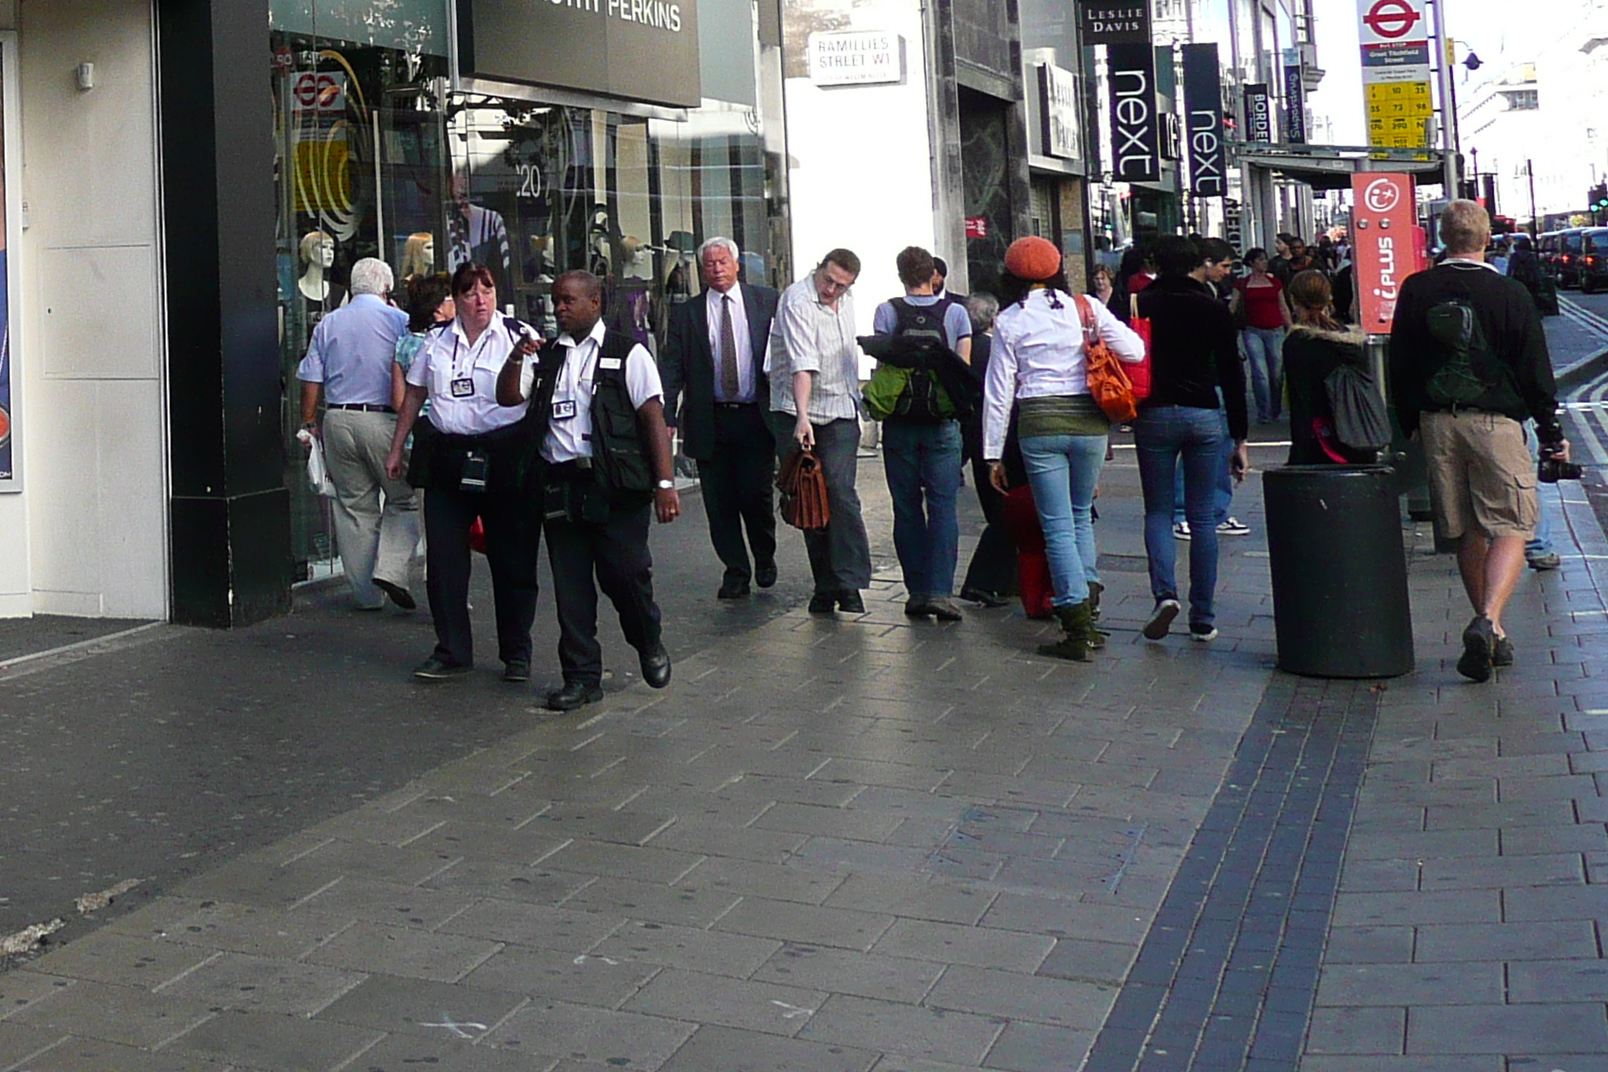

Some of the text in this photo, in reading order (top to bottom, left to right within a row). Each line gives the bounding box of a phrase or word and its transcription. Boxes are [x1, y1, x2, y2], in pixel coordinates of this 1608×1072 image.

[1088, 8, 1143, 20] LESLIE
[1093, 21, 1139, 33] DAVIS
[818, 37, 889, 52] RAMILLIES
[819, 53, 890, 68] STREET W1
[1114, 70, 1152, 176] next
[1190, 110, 1223, 193] next
